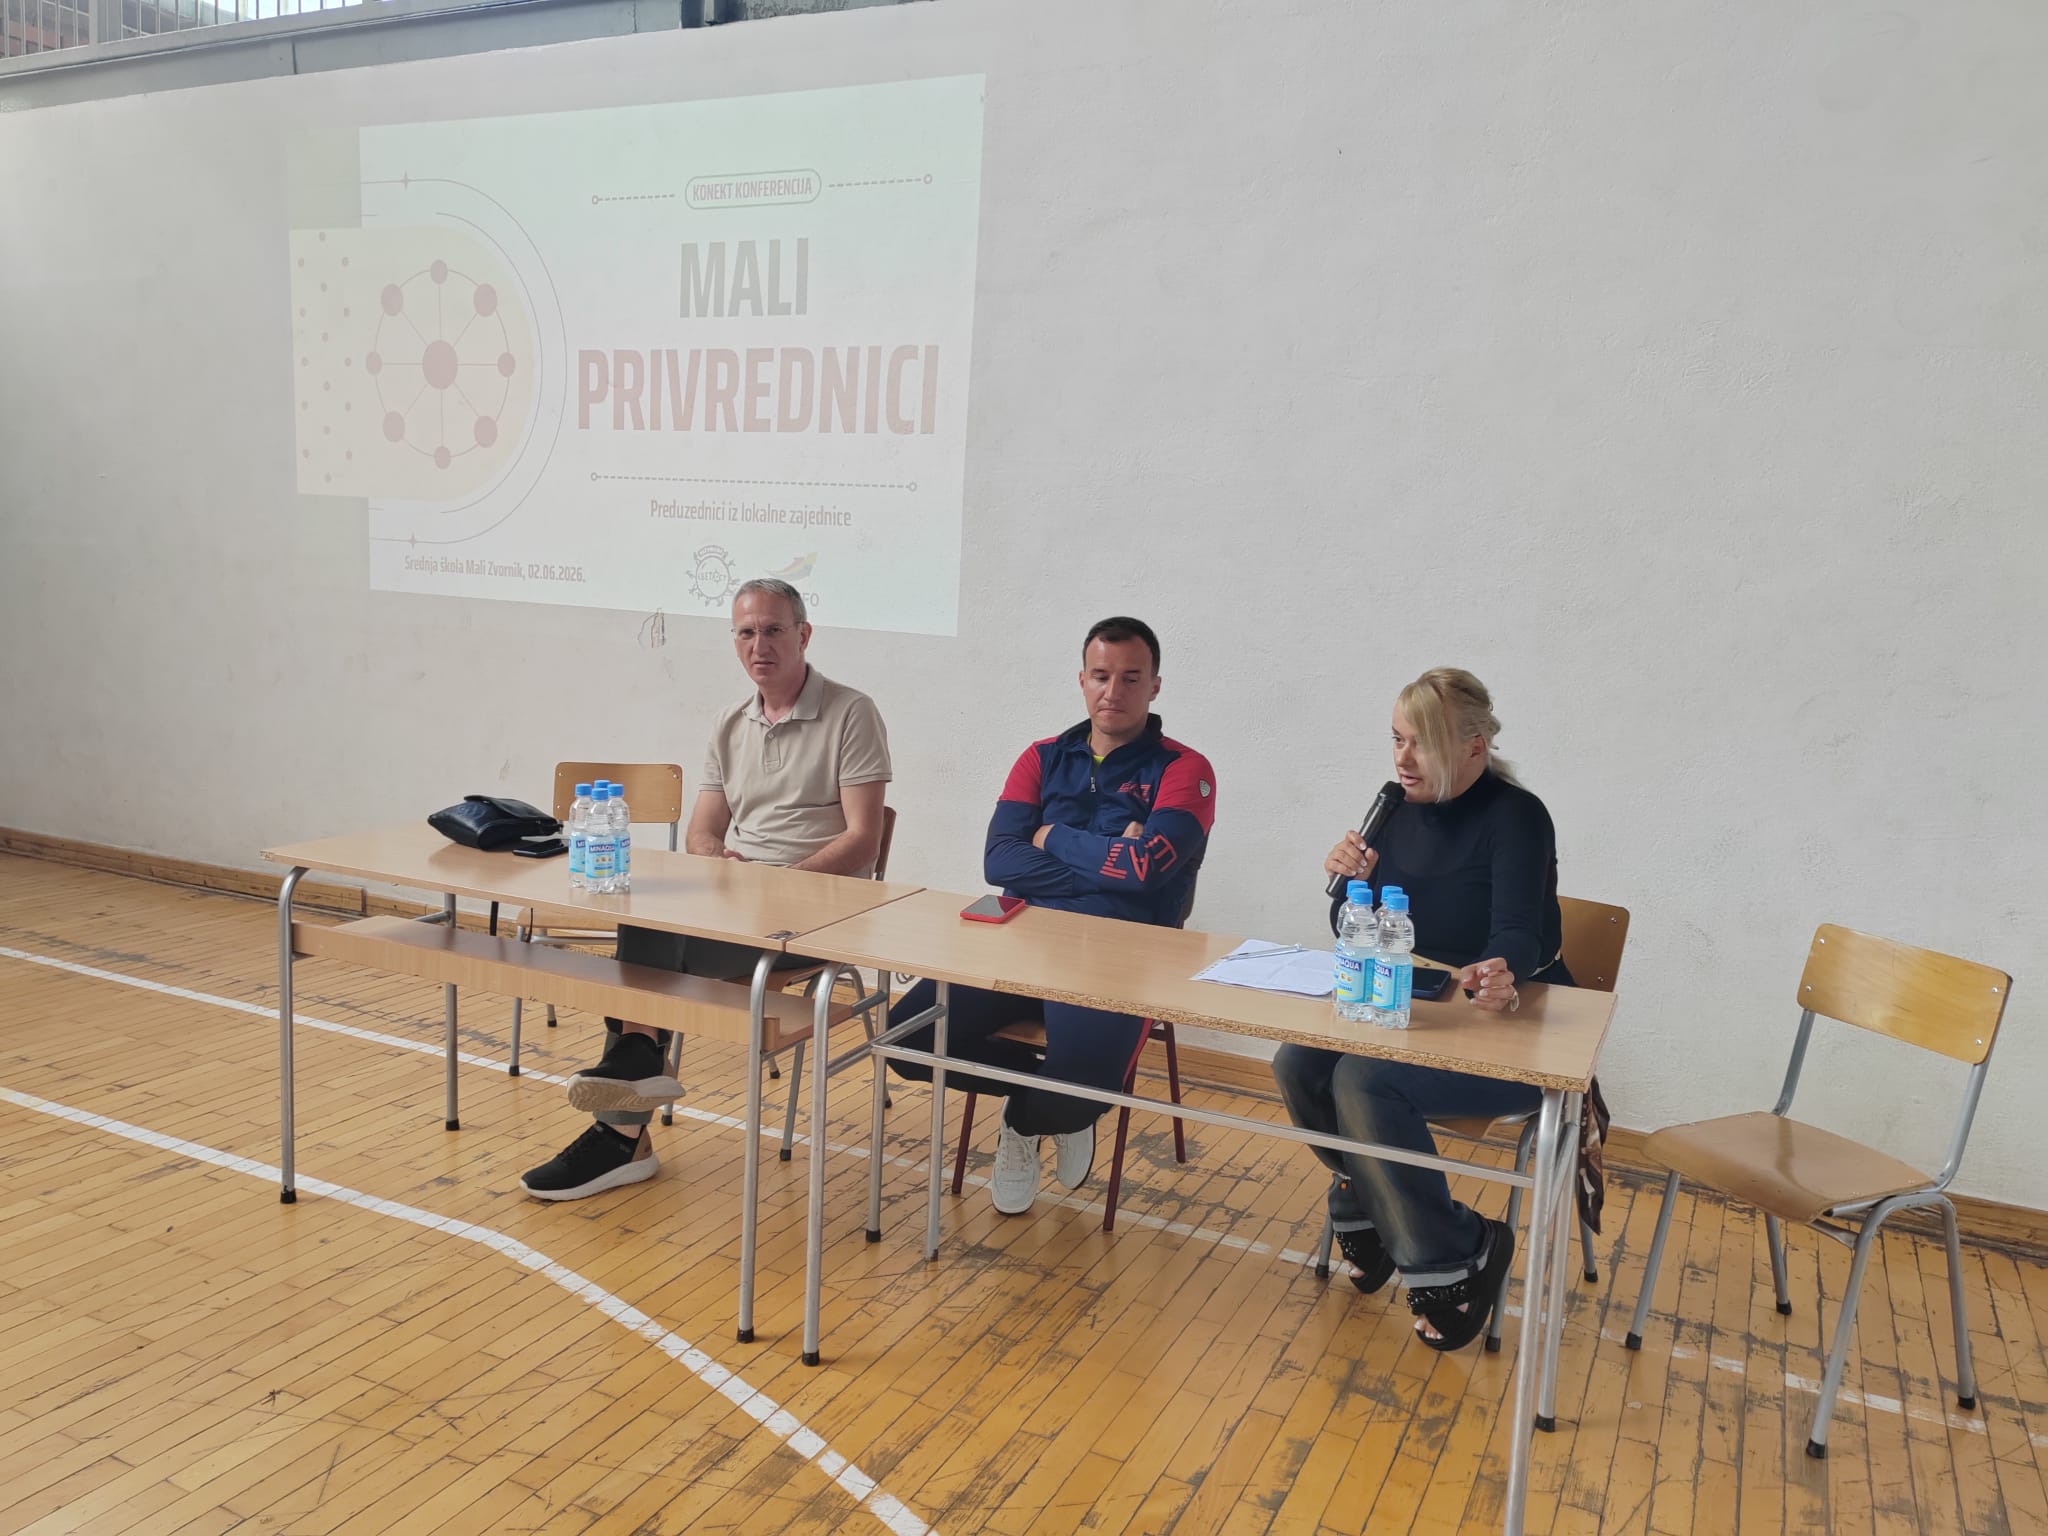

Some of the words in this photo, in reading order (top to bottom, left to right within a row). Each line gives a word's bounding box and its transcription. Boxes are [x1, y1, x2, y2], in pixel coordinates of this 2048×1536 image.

[692, 183, 733, 201] KONEKT
[735, 177, 813, 199] KONFERENCIJA
[679, 237, 809, 319] MALI
[577, 344, 940, 435] PRIVREDNICI
[650, 499, 726, 521] Preduzednici
[728, 502, 739, 522] iz
[741, 502, 787, 525] lokalne
[789, 505, 852, 529] zajednice
[404, 555, 438, 575] Srednja
[440, 556, 464, 575] škola
[466, 559, 486, 576] Mali
[487, 560, 526, 581] Zvornik,
[527, 563, 587, 583] 02.06.2026.
